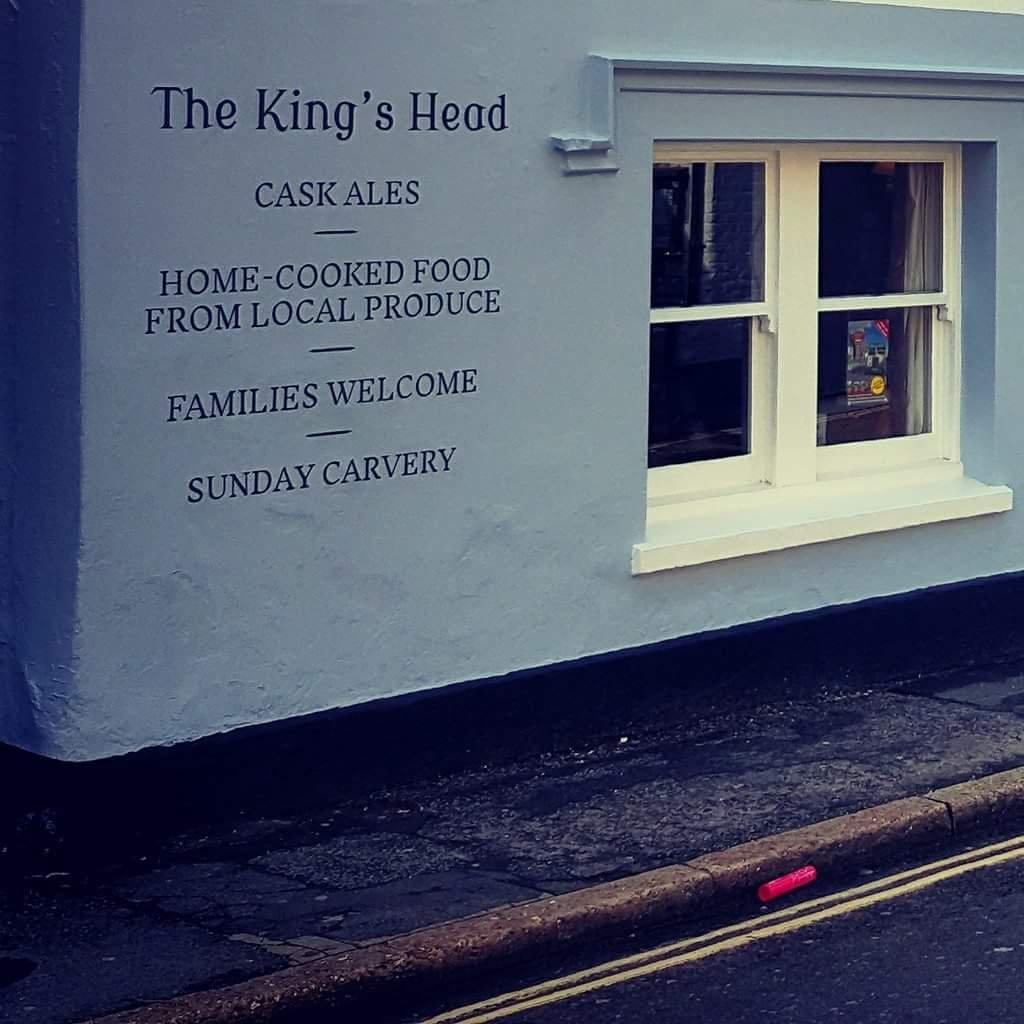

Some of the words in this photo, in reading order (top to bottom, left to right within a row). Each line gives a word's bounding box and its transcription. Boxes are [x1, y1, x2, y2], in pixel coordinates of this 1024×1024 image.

[151, 86, 237, 130] The
[255, 88, 395, 141] King's
[408, 91, 509, 132] Head
[255, 181, 337, 208] CASK
[344, 180, 420, 206] ALES
[160, 260, 404, 296] HOME-COOKED
[413, 257, 491, 284] FOOD
[144, 303, 242, 335] FROM
[251, 298, 355, 328] LOCAL
[364, 290, 501, 321] PRODUCE
[166, 383, 318, 422] FAMILIES
[327, 369, 478, 406] WELCOME
[187, 464, 316, 503] SUNDAY
[323, 448, 456, 485] CARVERY
